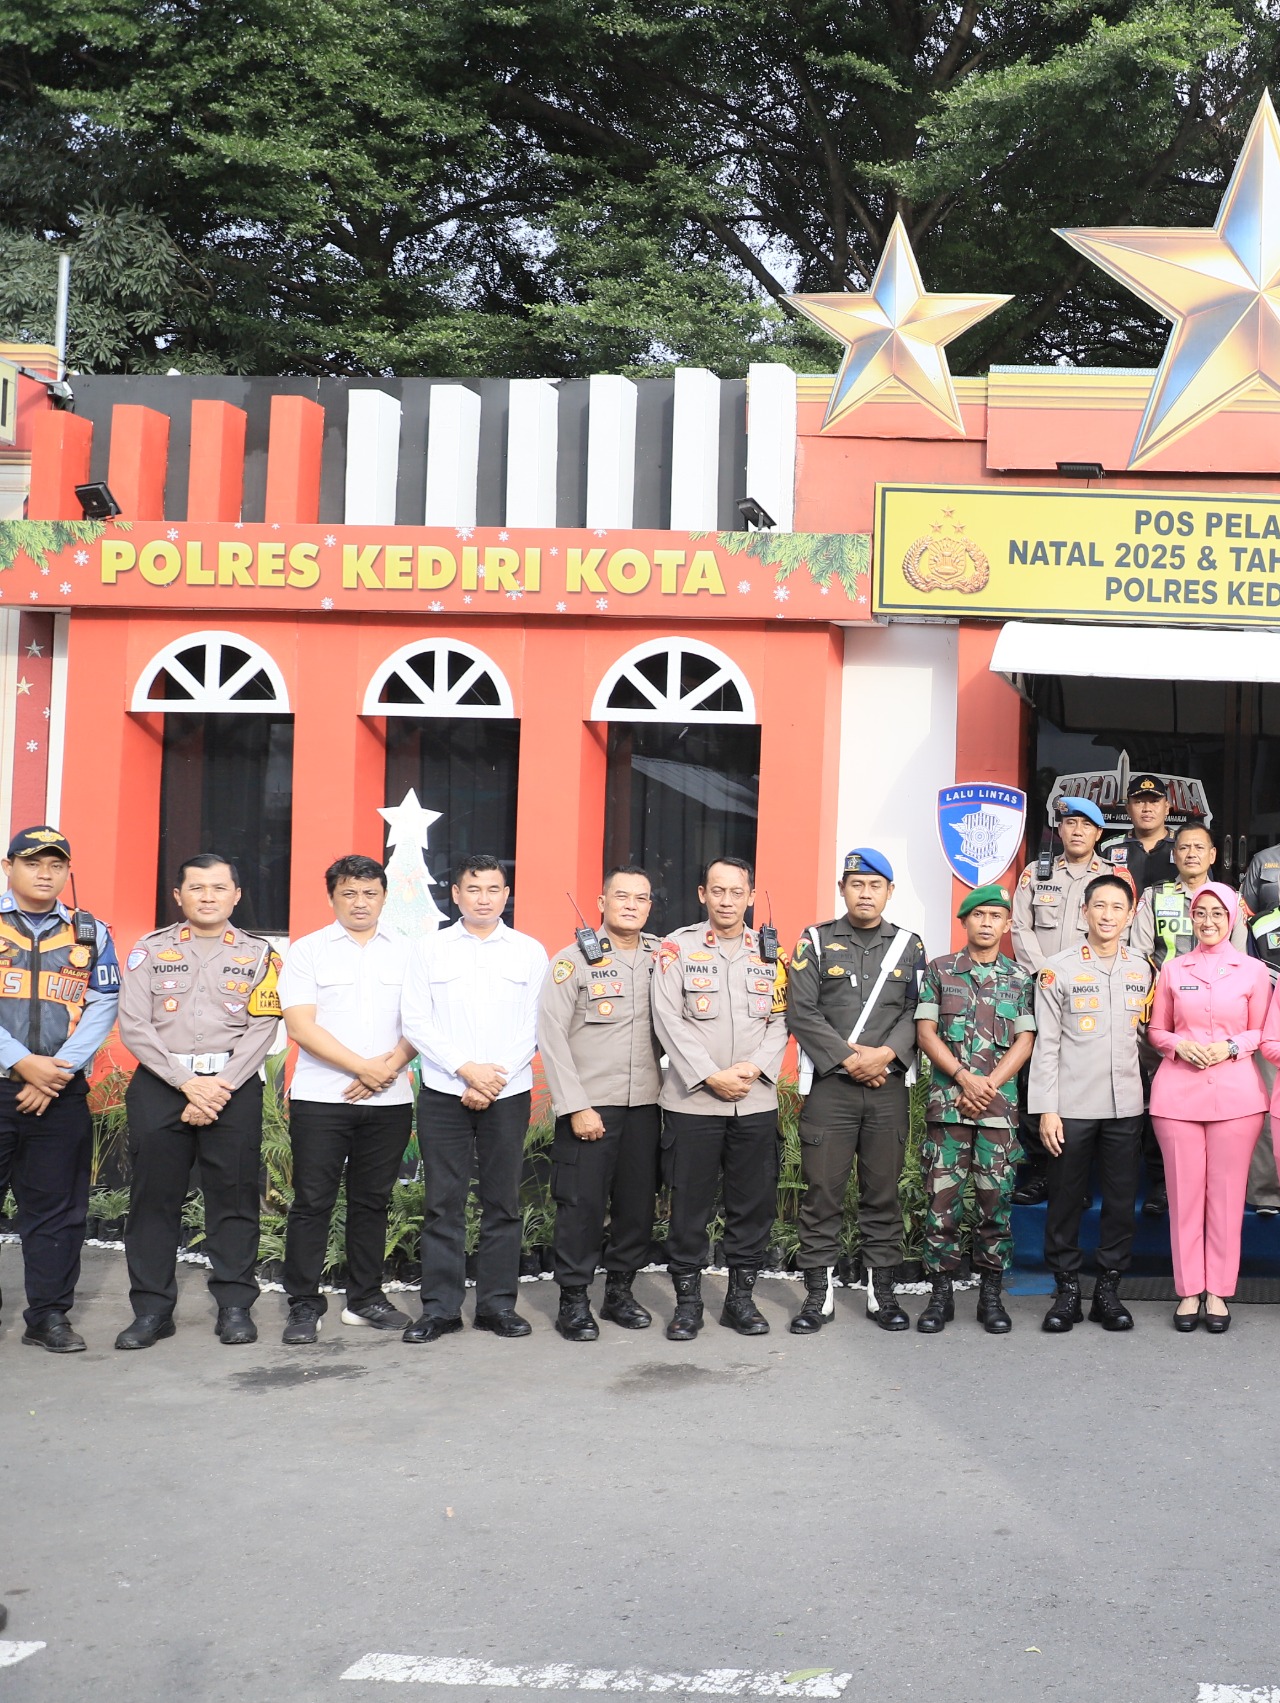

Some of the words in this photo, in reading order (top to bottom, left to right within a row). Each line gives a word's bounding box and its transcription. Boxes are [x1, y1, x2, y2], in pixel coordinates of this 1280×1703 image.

[1134, 509, 1195, 536] POS
[1008, 539, 1105, 567] NATAL
[1114, 542, 1186, 570] 2025
[1196, 543, 1218, 571] &
[101, 540, 322, 590] POLRES
[342, 545, 541, 593] KEDIRI
[566, 548, 727, 597] KOTA
[1105, 576, 1218, 605] POLRES
[946, 790, 974, 801] LALU
[979, 790, 1018, 804] LINTAS
[1037, 884, 1062, 892] DIDIK
[63, 968, 89, 979] DALOPS
[152, 964, 189, 974] YUDHO
[591, 969, 618, 979] RIKO
[685, 964, 709, 973] IWAN
[712, 965, 718, 974] S
[747, 967, 775, 977] POLRI
[47, 975, 85, 1003] HUB
[1126, 984, 1146, 994] POLRI
